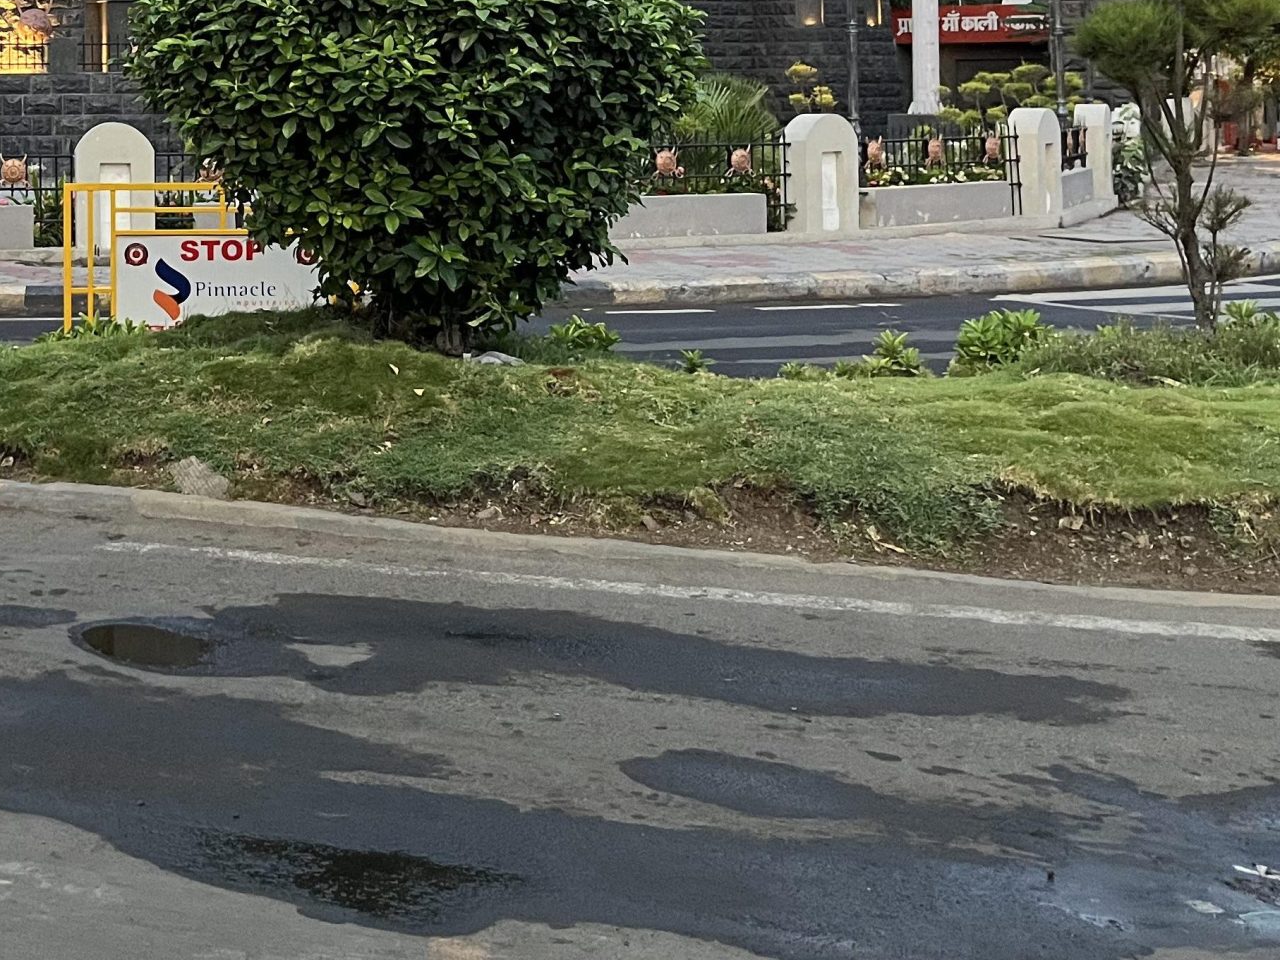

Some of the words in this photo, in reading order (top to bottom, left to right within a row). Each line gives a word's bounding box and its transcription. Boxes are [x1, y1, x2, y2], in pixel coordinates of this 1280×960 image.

[961, 11, 1000, 32] काली
[180, 239, 263, 262] STOP
[195, 281, 277, 297] Pinnacle
